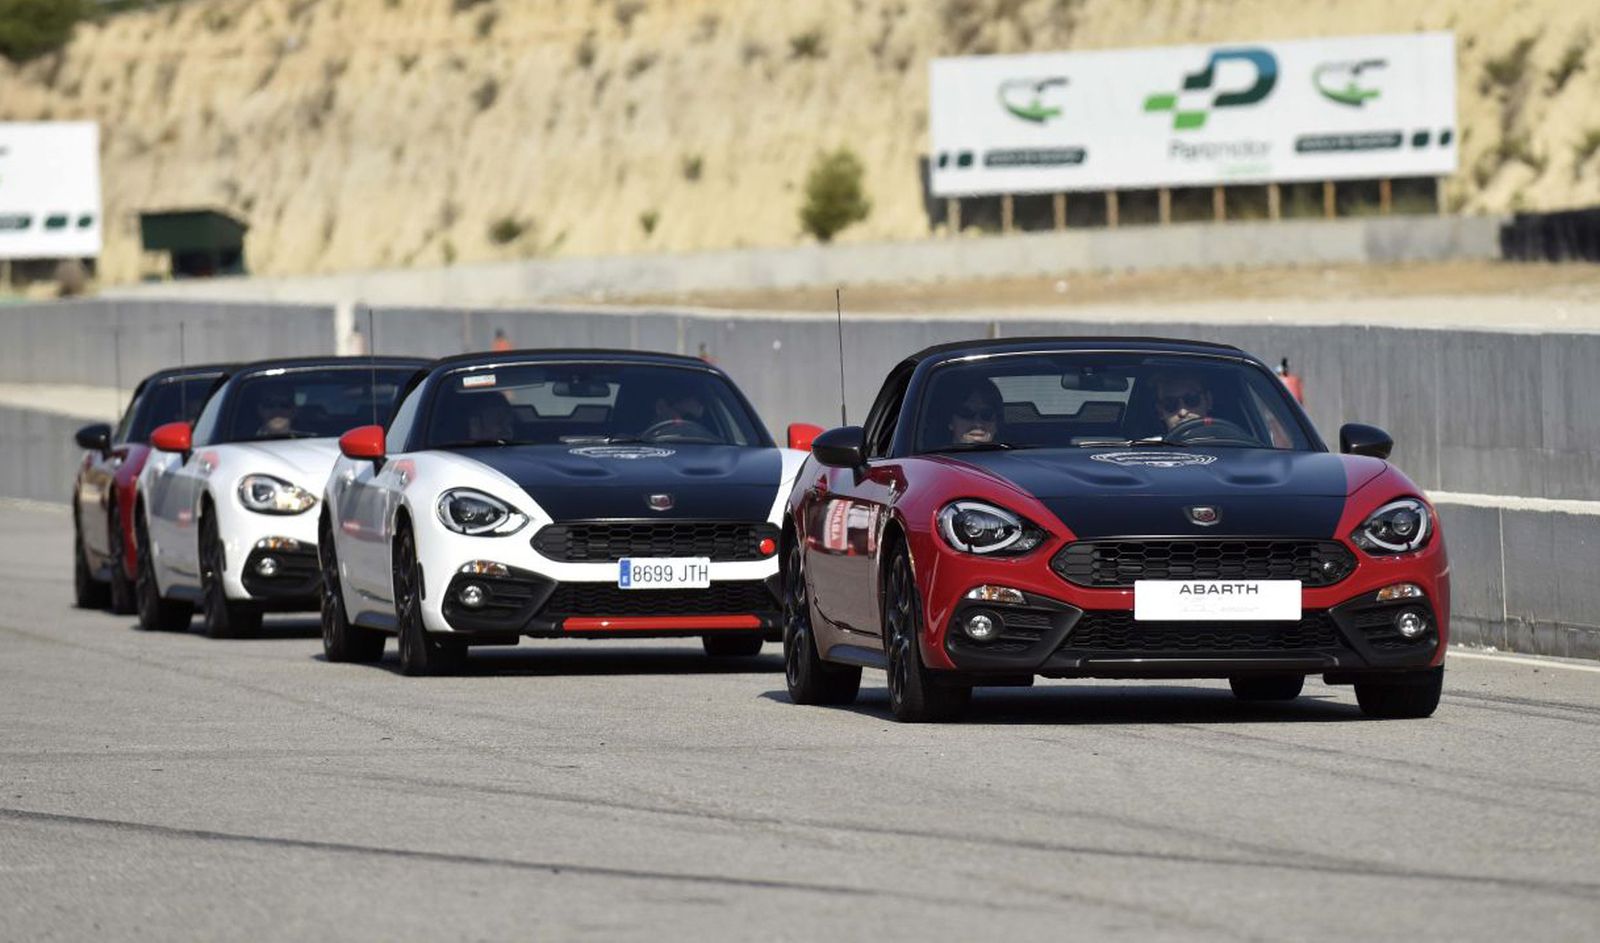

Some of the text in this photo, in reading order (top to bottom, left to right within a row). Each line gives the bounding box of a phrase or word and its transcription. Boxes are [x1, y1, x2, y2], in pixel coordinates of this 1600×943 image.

[632, 564, 673, 582] 8699
[678, 564, 708, 582] JTH
[1179, 583, 1259, 595] ABARTH
